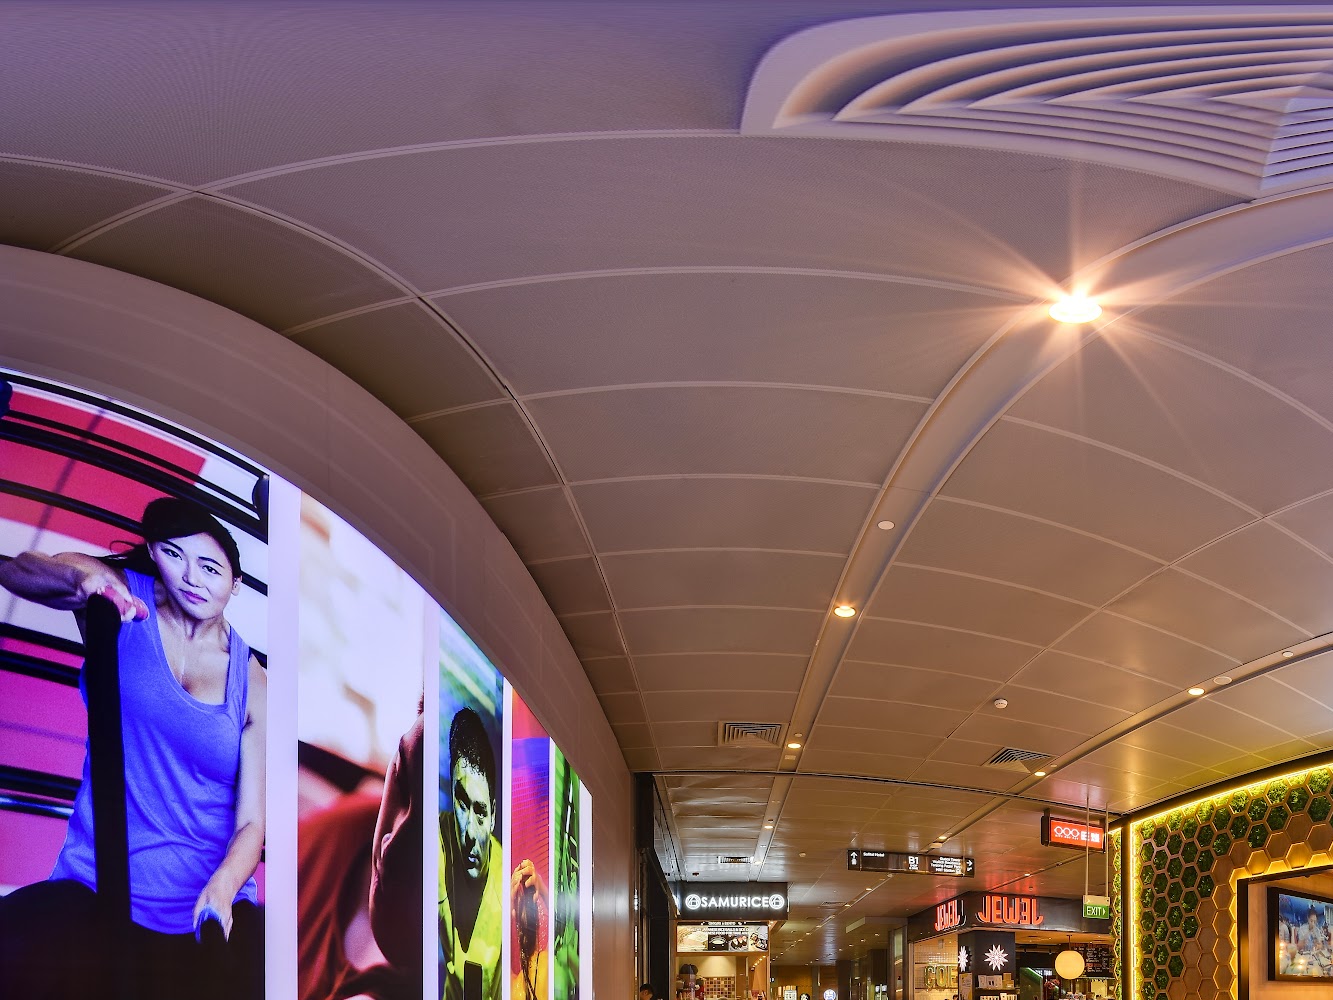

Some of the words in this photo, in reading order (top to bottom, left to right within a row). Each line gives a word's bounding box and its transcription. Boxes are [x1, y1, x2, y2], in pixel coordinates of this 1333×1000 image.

[700, 896, 770, 908] SAMURICE
[977, 895, 1044, 926] JEWEL
[1086, 906, 1102, 916] EXIT
